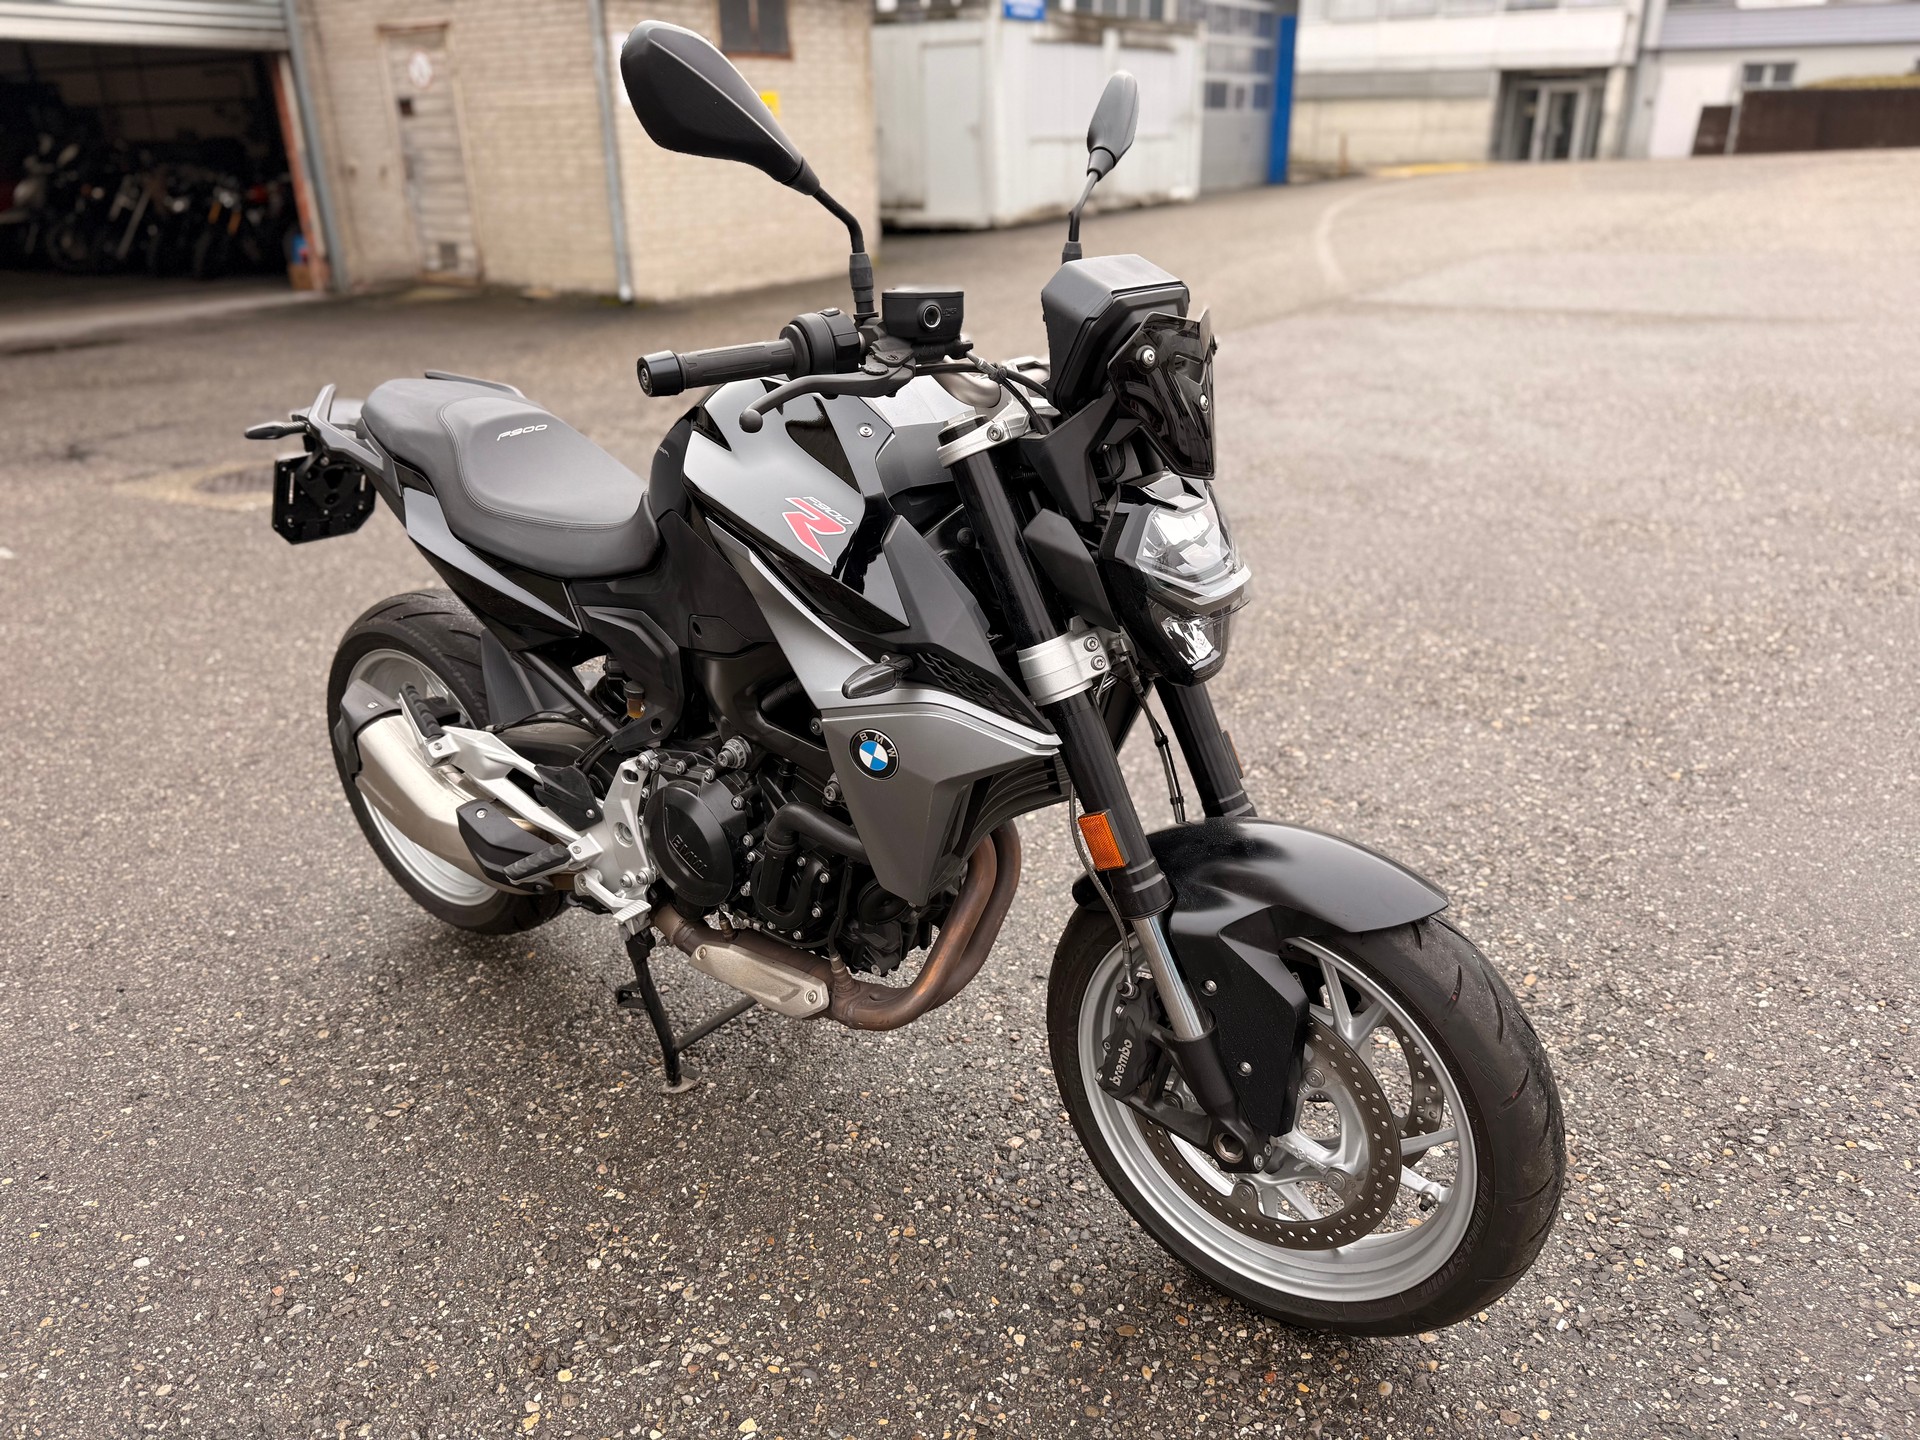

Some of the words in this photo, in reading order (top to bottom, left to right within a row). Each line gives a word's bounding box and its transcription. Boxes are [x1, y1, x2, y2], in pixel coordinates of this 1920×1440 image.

[496, 424, 548, 441] F900
[782, 497, 847, 565] R
[859, 732, 897, 758] BMW
[1108, 1038, 1133, 1087] brembo
